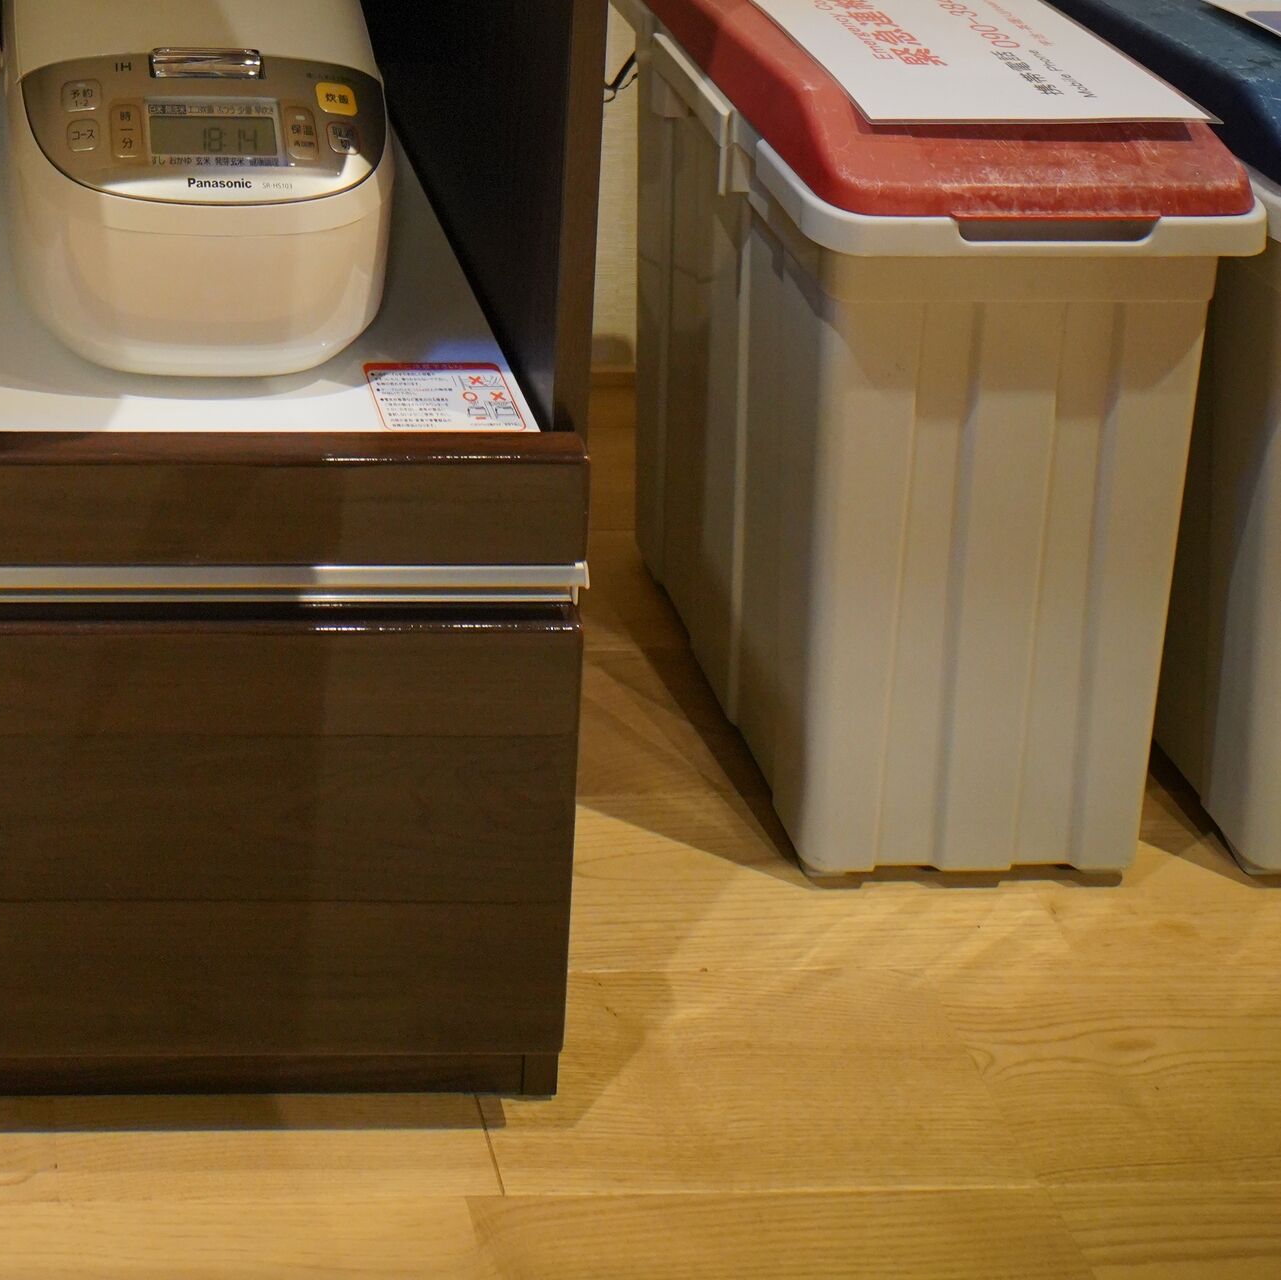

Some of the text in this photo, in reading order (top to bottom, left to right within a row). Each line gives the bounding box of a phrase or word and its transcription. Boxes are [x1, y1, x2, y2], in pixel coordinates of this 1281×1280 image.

[832, 13, 894, 61] Emergency
[115, 62, 132, 72] IH
[990, 50, 1065, 97] 携帯電話
[1027, 48, 1098, 98] Mobile Phone
[69, 88, 93, 100] 予約
[325, 92, 350, 105] 炊飯
[71, 128, 95, 141] コース
[291, 124, 314, 136] 保温
[187, 178, 253, 190] Panasonic
